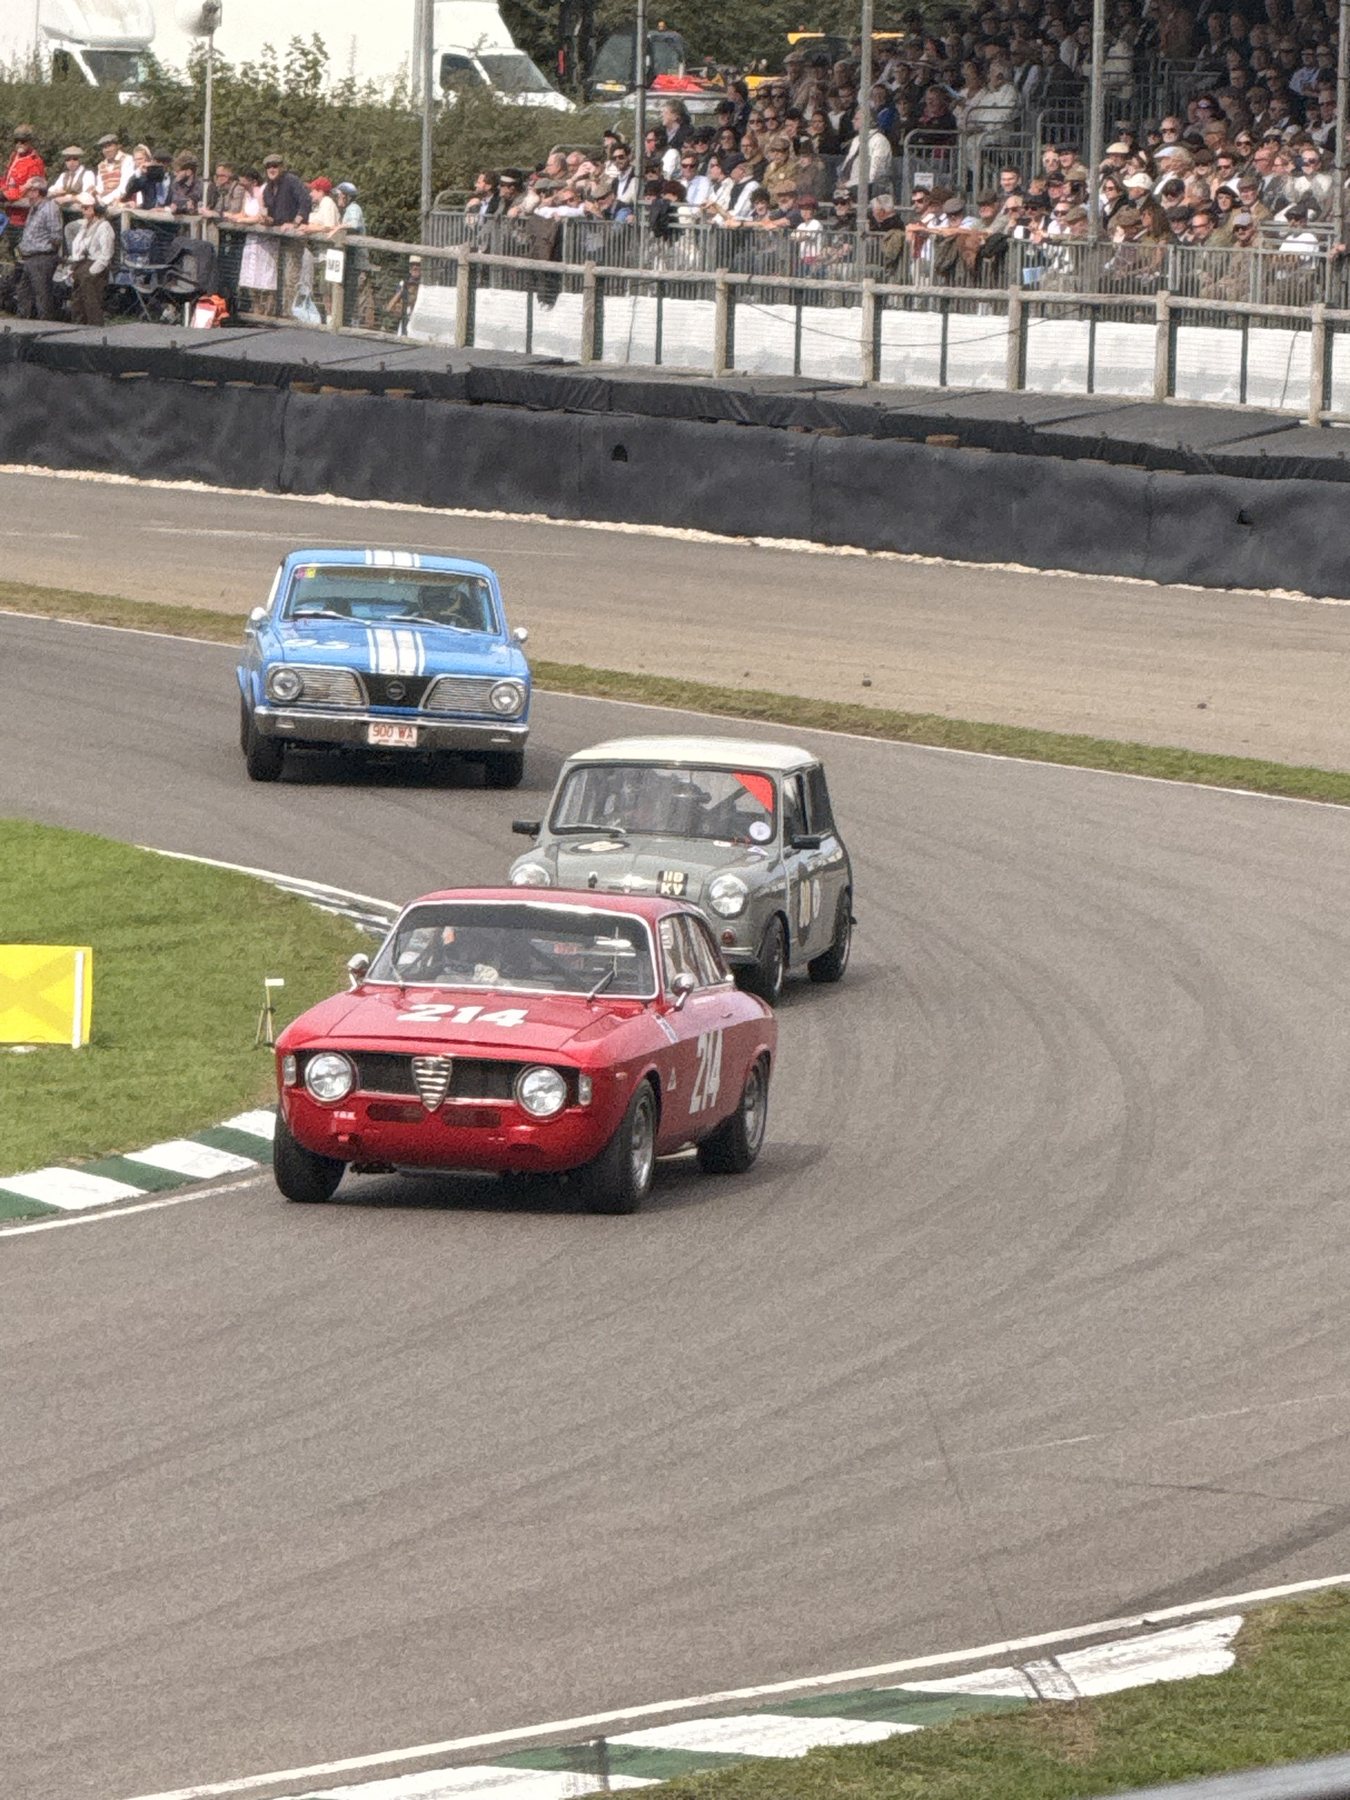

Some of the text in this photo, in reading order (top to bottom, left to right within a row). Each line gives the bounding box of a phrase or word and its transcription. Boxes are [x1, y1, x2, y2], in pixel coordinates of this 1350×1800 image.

[372, 724, 414, 740] 900 WA
[660, 882, 684, 895] KV
[396, 1003, 529, 1027] 214
[688, 1028, 723, 1114] 214
